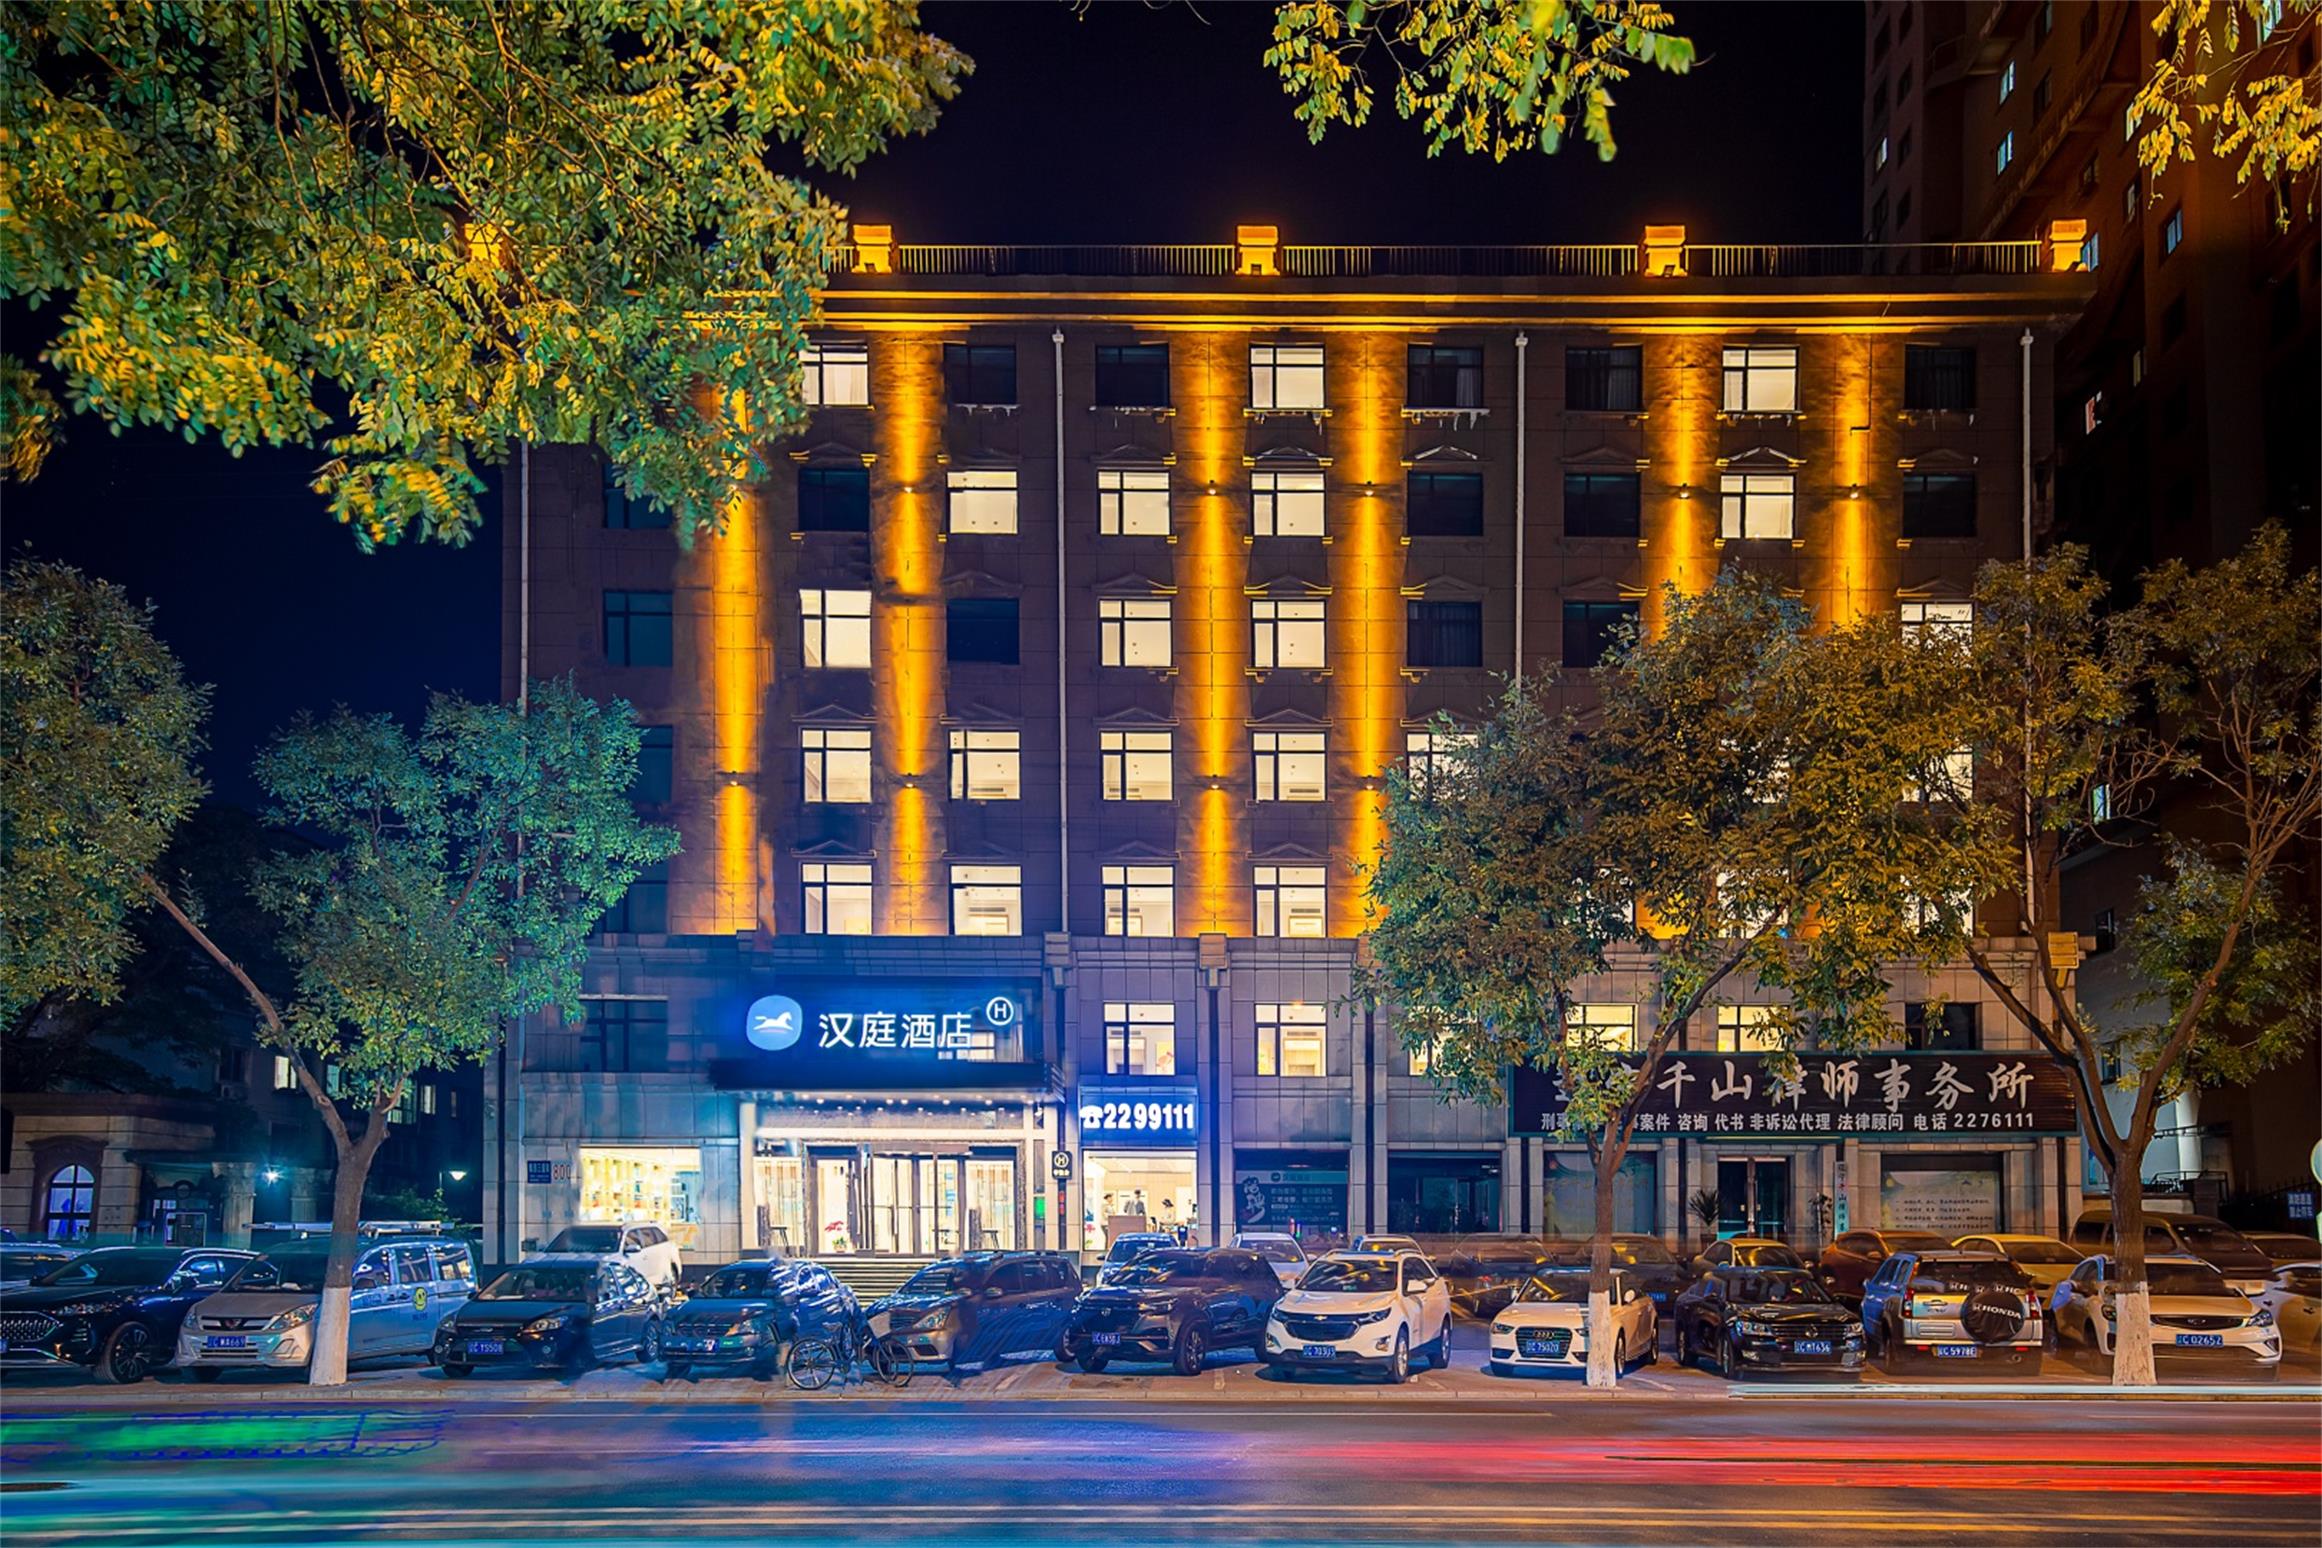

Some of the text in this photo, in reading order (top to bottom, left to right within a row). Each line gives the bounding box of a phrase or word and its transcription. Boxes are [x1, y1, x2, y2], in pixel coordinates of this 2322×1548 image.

[819, 1011, 972, 1049] 汉庭酒店
[1552, 1058, 2035, 1113] 千山律师事务所
[1103, 1103, 1194, 1130] 2299111
[1678, 1113, 1709, 1131] 咨询
[1715, 1113, 1744, 1131] 代书
[1750, 1113, 1831, 1131] 非诉讼代理
[1837, 1113, 1904, 1131] 法律顾问
[1914, 1114, 1947, 1131] 电话
[1954, 1112, 2034, 1128] 2276111
[1982, 1304, 2021, 1319] HONDA
